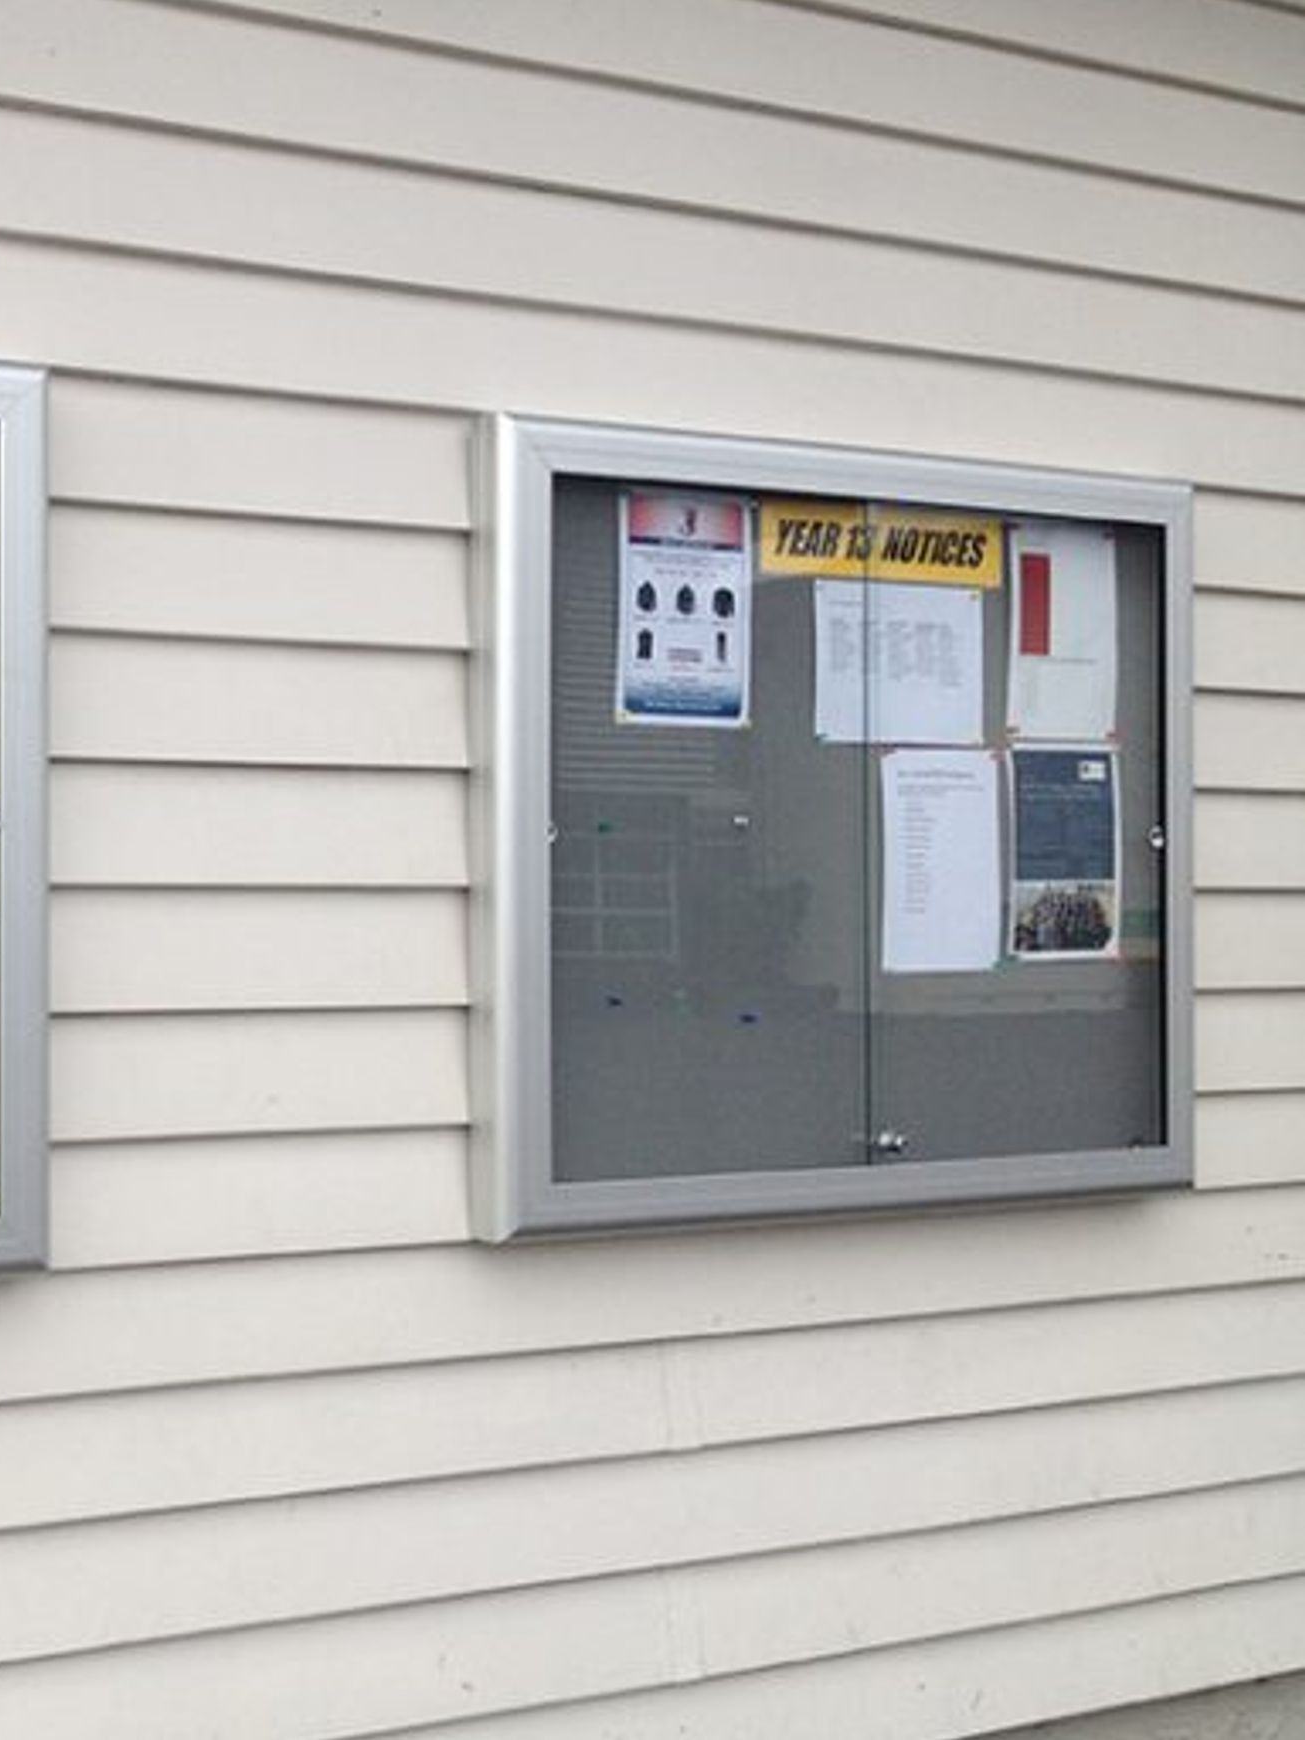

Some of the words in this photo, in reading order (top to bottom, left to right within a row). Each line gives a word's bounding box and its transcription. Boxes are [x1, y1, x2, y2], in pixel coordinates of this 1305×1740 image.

[776, 518, 842, 558] YEAR
[845, 524, 878, 561] 13
[881, 525, 988, 570] NOTICES
